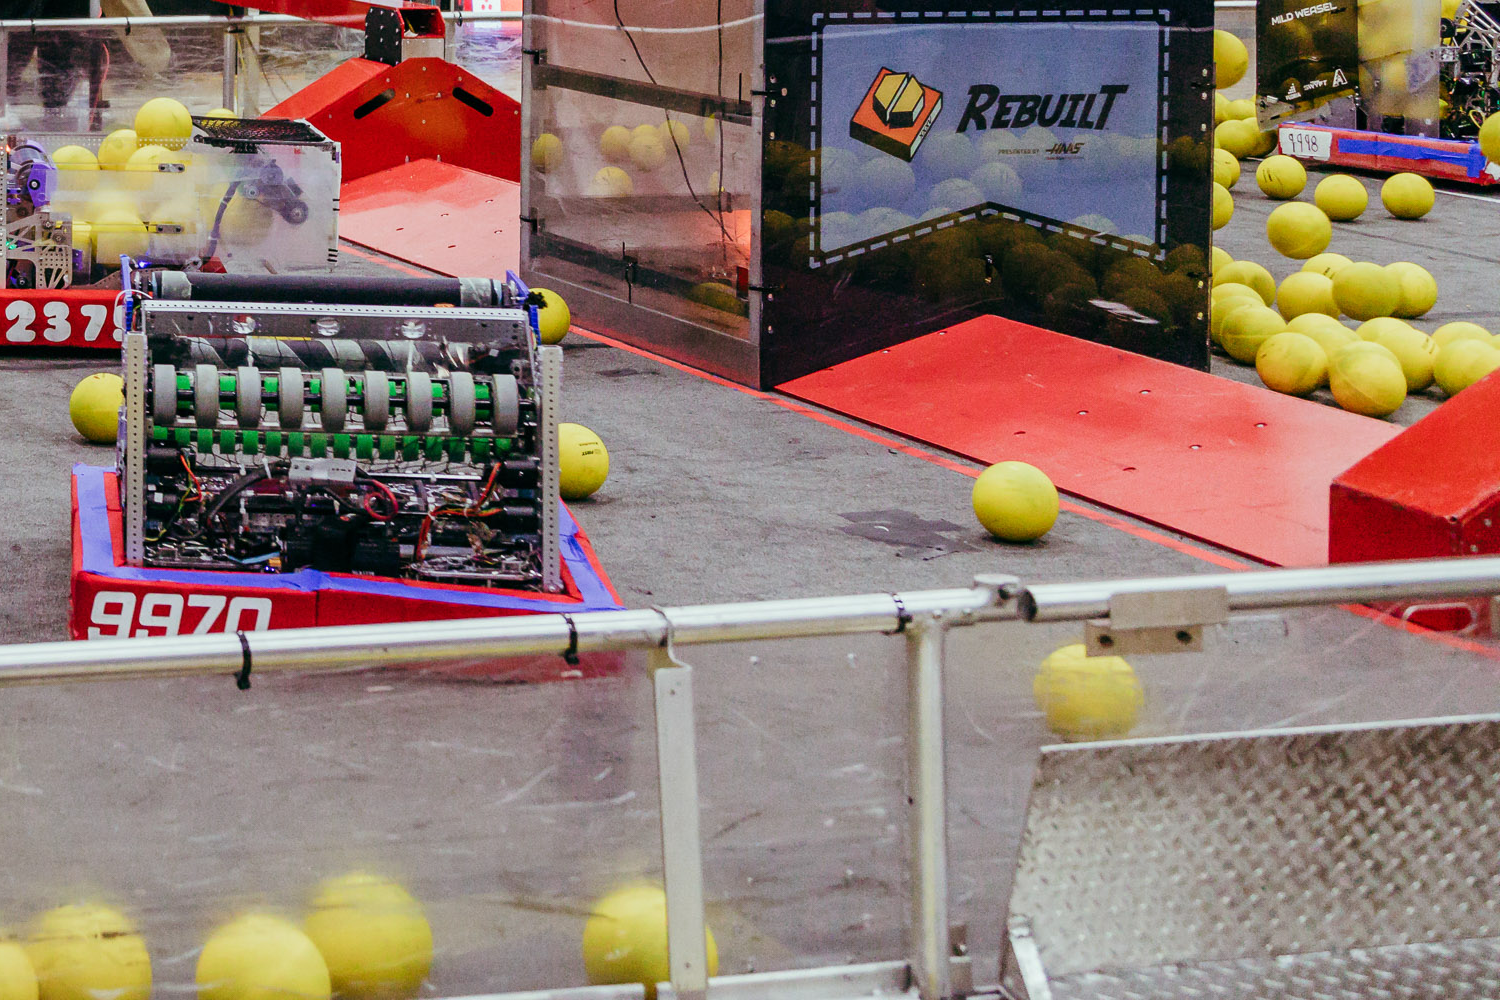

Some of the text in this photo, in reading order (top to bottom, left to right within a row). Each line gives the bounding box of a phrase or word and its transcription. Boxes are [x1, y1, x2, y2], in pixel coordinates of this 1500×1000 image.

[1271, 2, 1337, 26] MILD WEASEL
[955, 84, 1129, 134] REBUILT
[1288, 133, 1318, 153] 9998
[87, 591, 273, 641] 9970
